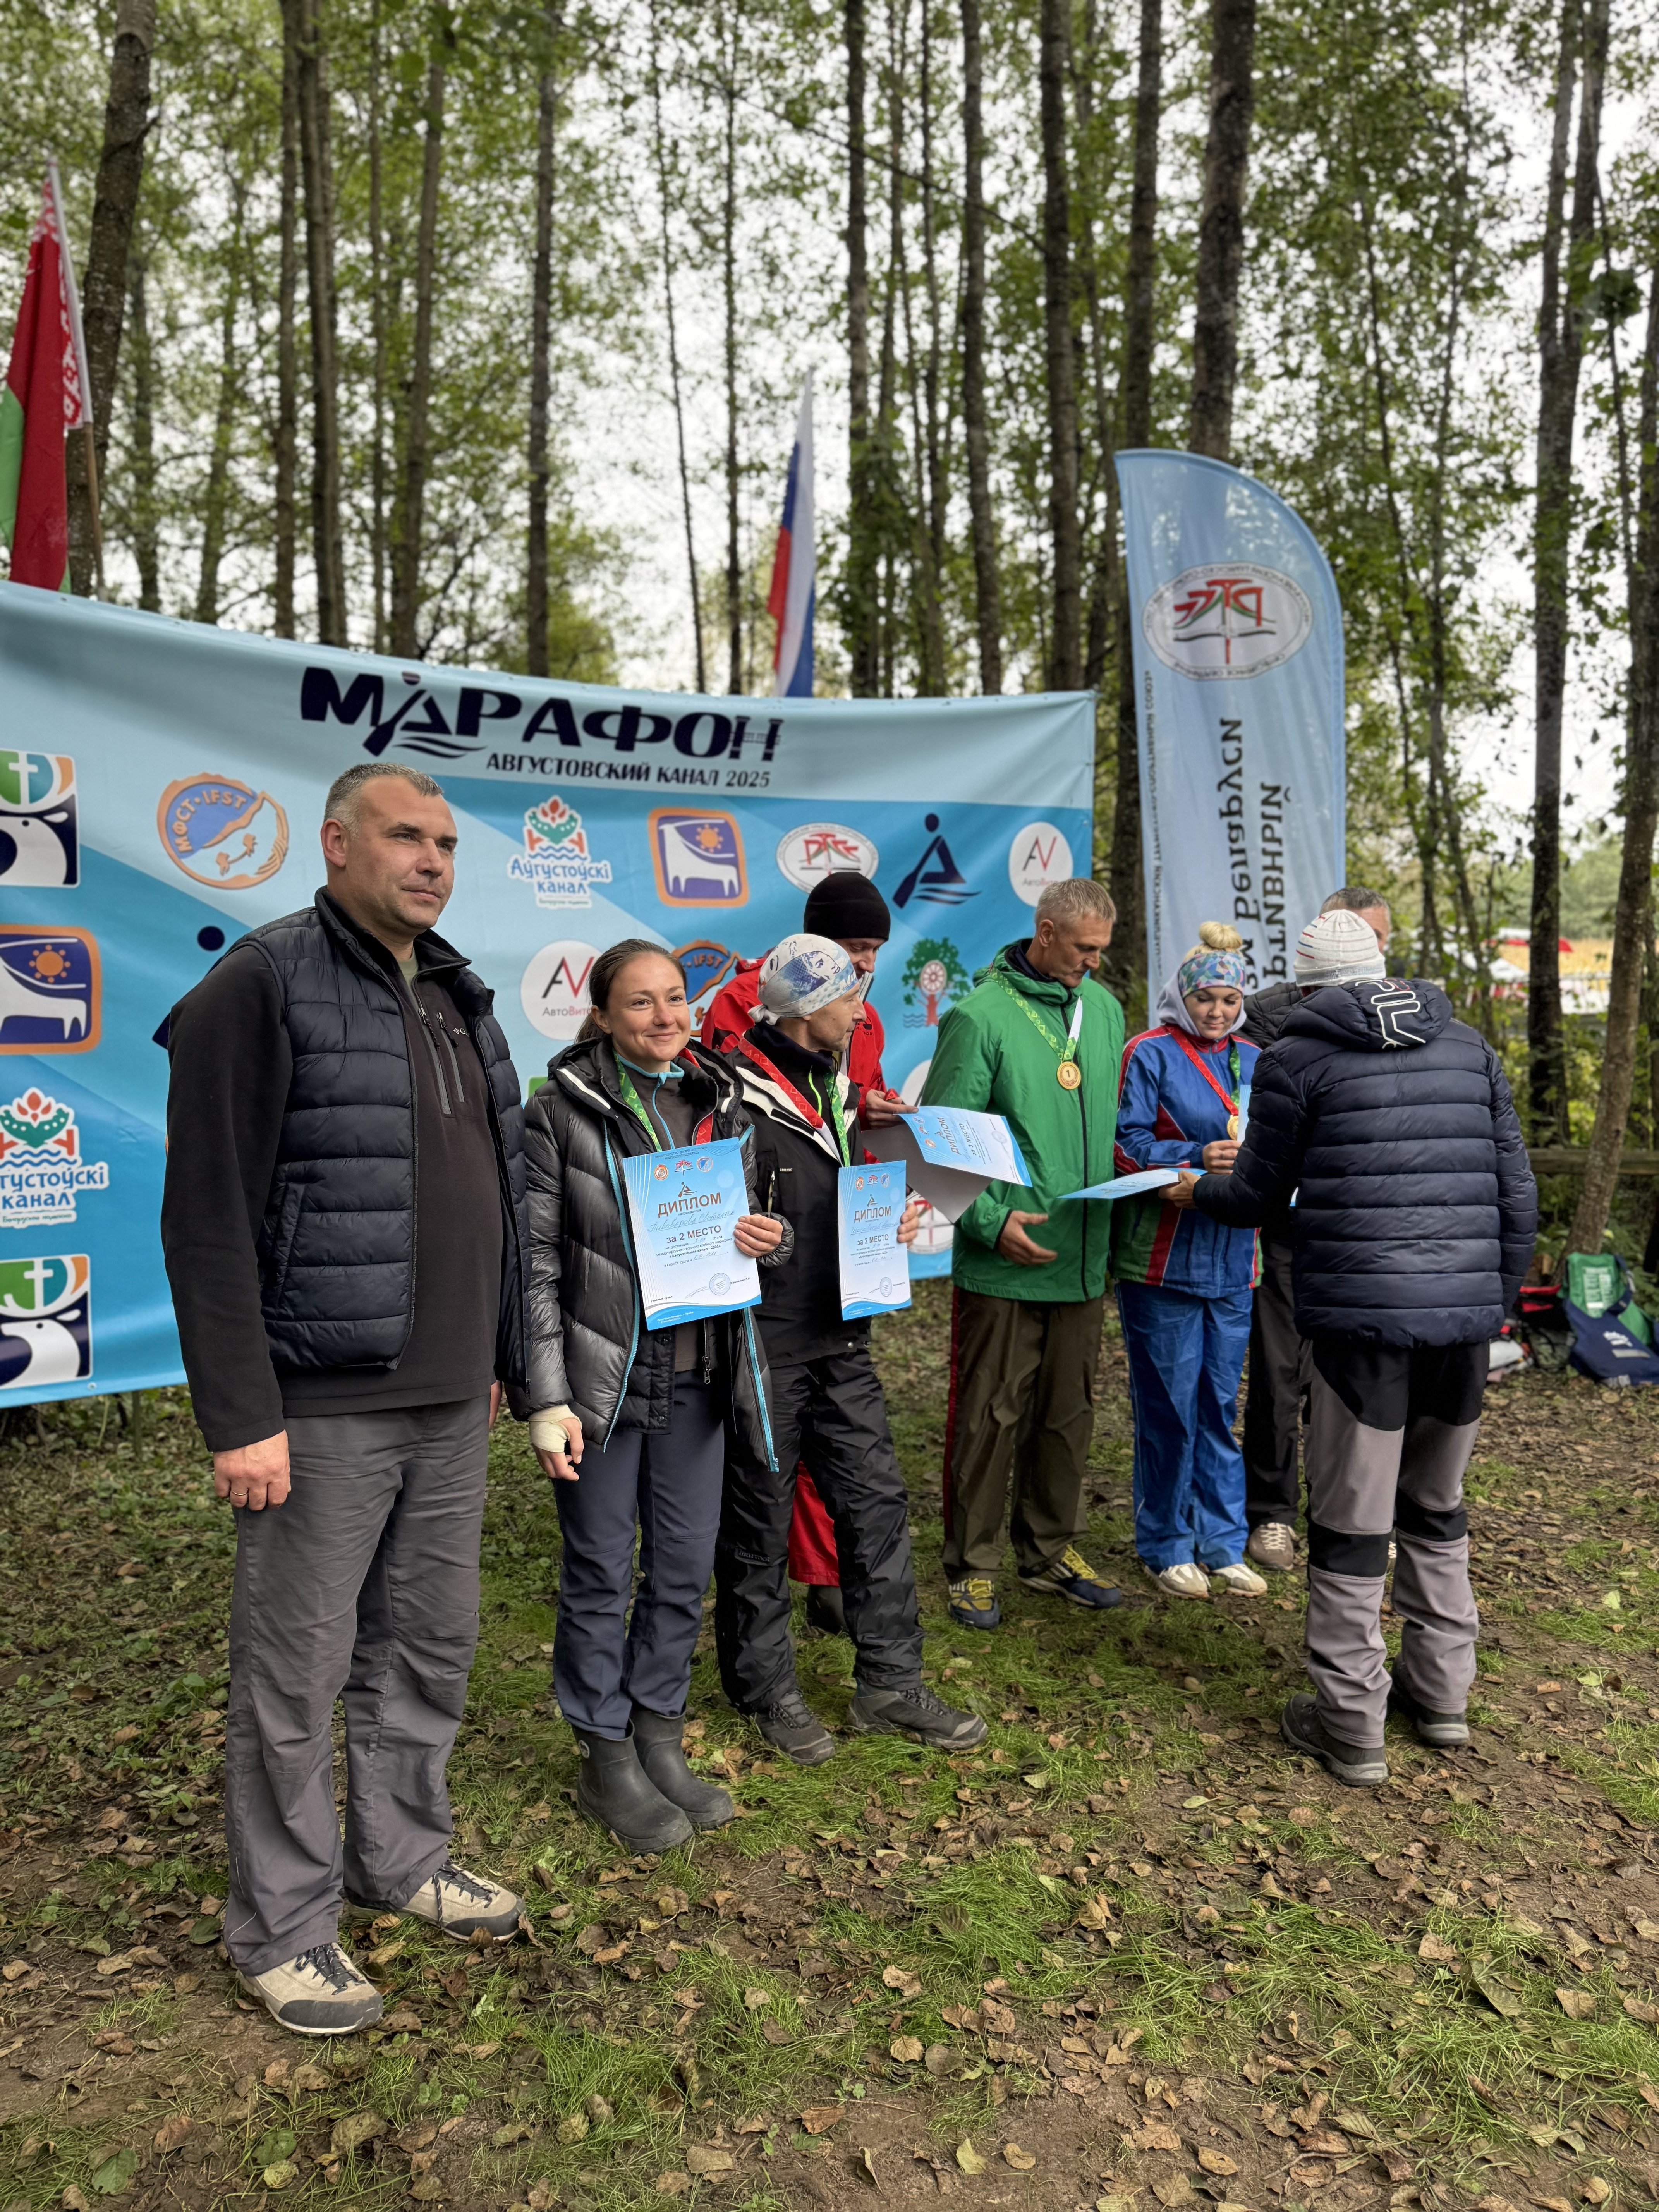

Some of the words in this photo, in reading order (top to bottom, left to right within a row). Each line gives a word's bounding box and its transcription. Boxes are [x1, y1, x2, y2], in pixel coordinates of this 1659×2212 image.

[300, 666, 784, 760] МАРАФОН
[486, 752, 649, 783] АВГУСТОВСКИЙ
[657, 767, 719, 787] КАНАЛ
[725, 771, 771, 788] 2025
[201, 789, 247, 810] IFST
[511, 858, 609, 881] Аўгустоўскі
[537, 881, 587, 894] канал
[693, 953, 724, 969] IFST
[1066, 1070, 1070, 1078] 1
[936, 1116, 962, 1156] ДИПЛОМ
[0, 1166, 105, 1192] густоўскі
[2, 1192, 71, 1209] канал
[658, 1192, 721, 1218] ДИПЛОМ
[854, 1206, 891, 1223] ДИПЛОМ
[679, 1233, 685, 1241] 2
[687, 1225, 721, 1238] МЕСТО
[869, 1234, 889, 1243] МЕСТО
